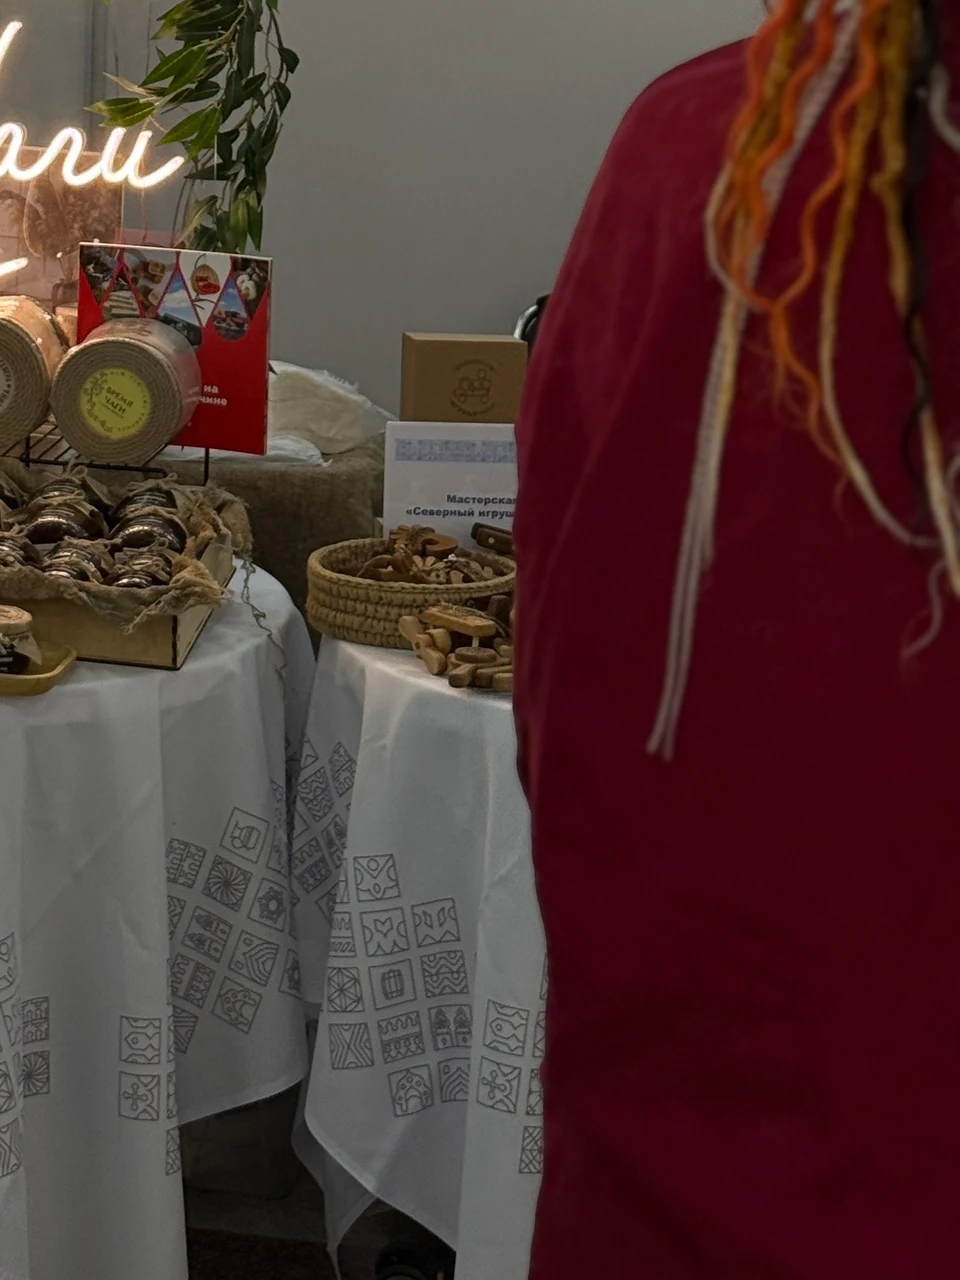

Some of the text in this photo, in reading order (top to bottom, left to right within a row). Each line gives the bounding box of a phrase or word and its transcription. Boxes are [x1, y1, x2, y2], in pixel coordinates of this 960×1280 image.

[105, 395, 127, 414] ЧАГИ
[106, 386, 134, 408] ВРЕМЯ
[405, 506, 514, 519] «Северный игруш
